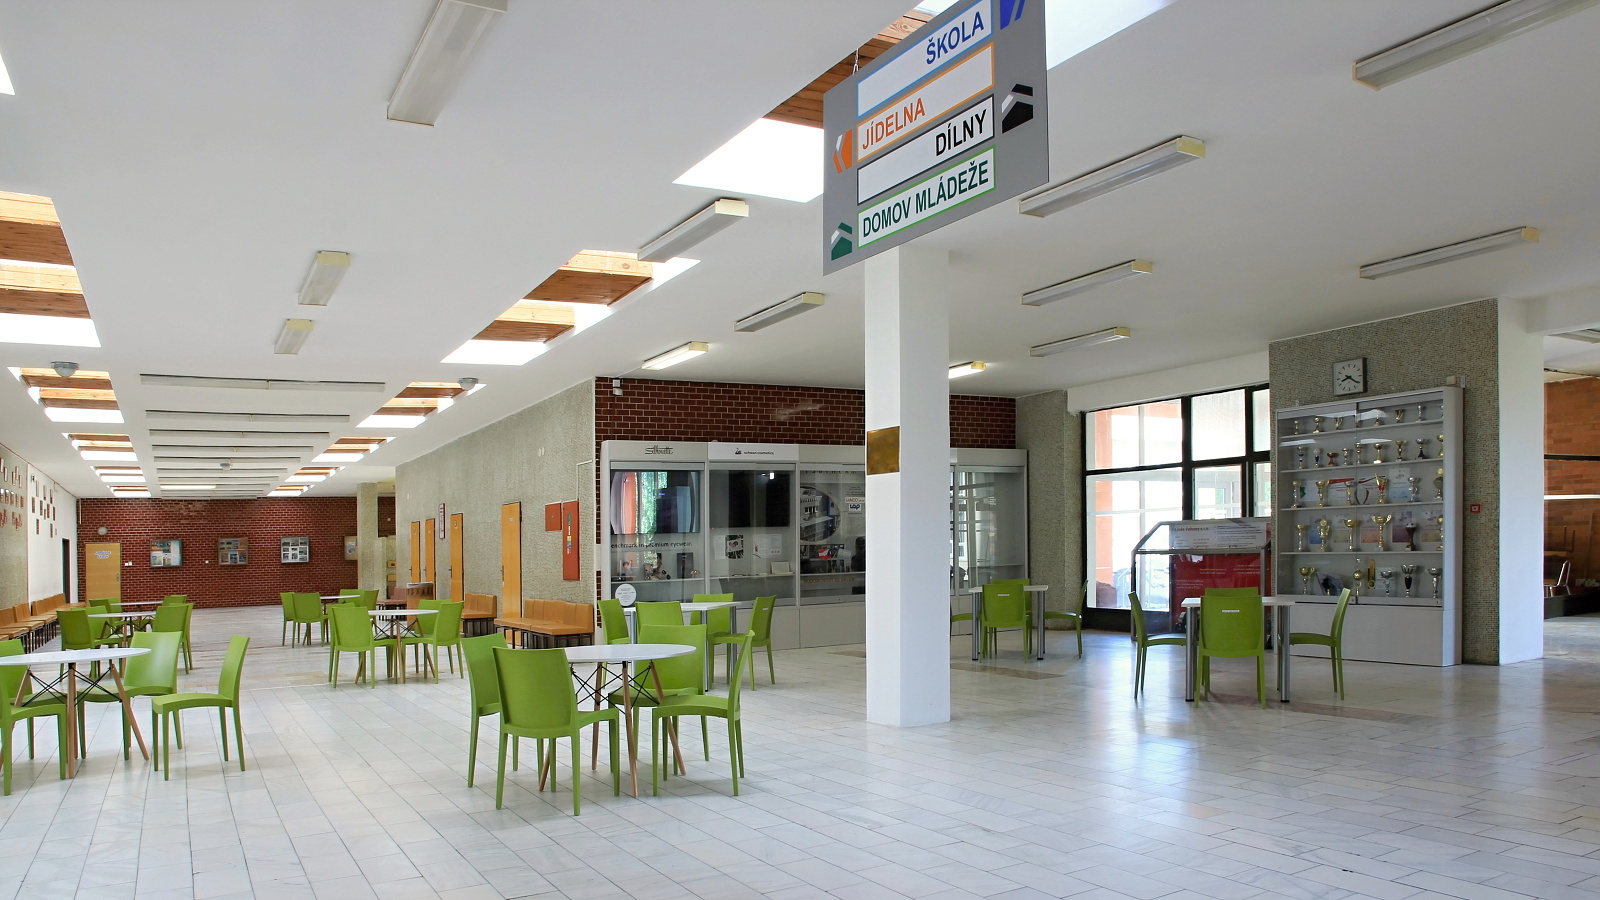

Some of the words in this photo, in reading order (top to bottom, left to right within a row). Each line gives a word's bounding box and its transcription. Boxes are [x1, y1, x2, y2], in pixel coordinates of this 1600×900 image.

[925, 11, 985, 65] ŠKOLA
[861, 97, 926, 150] JÍDELNA
[935, 108, 987, 157] DÍLNY
[862, 196, 912, 238] DOMOV
[915, 159, 989, 214] MLÁDEŽE
